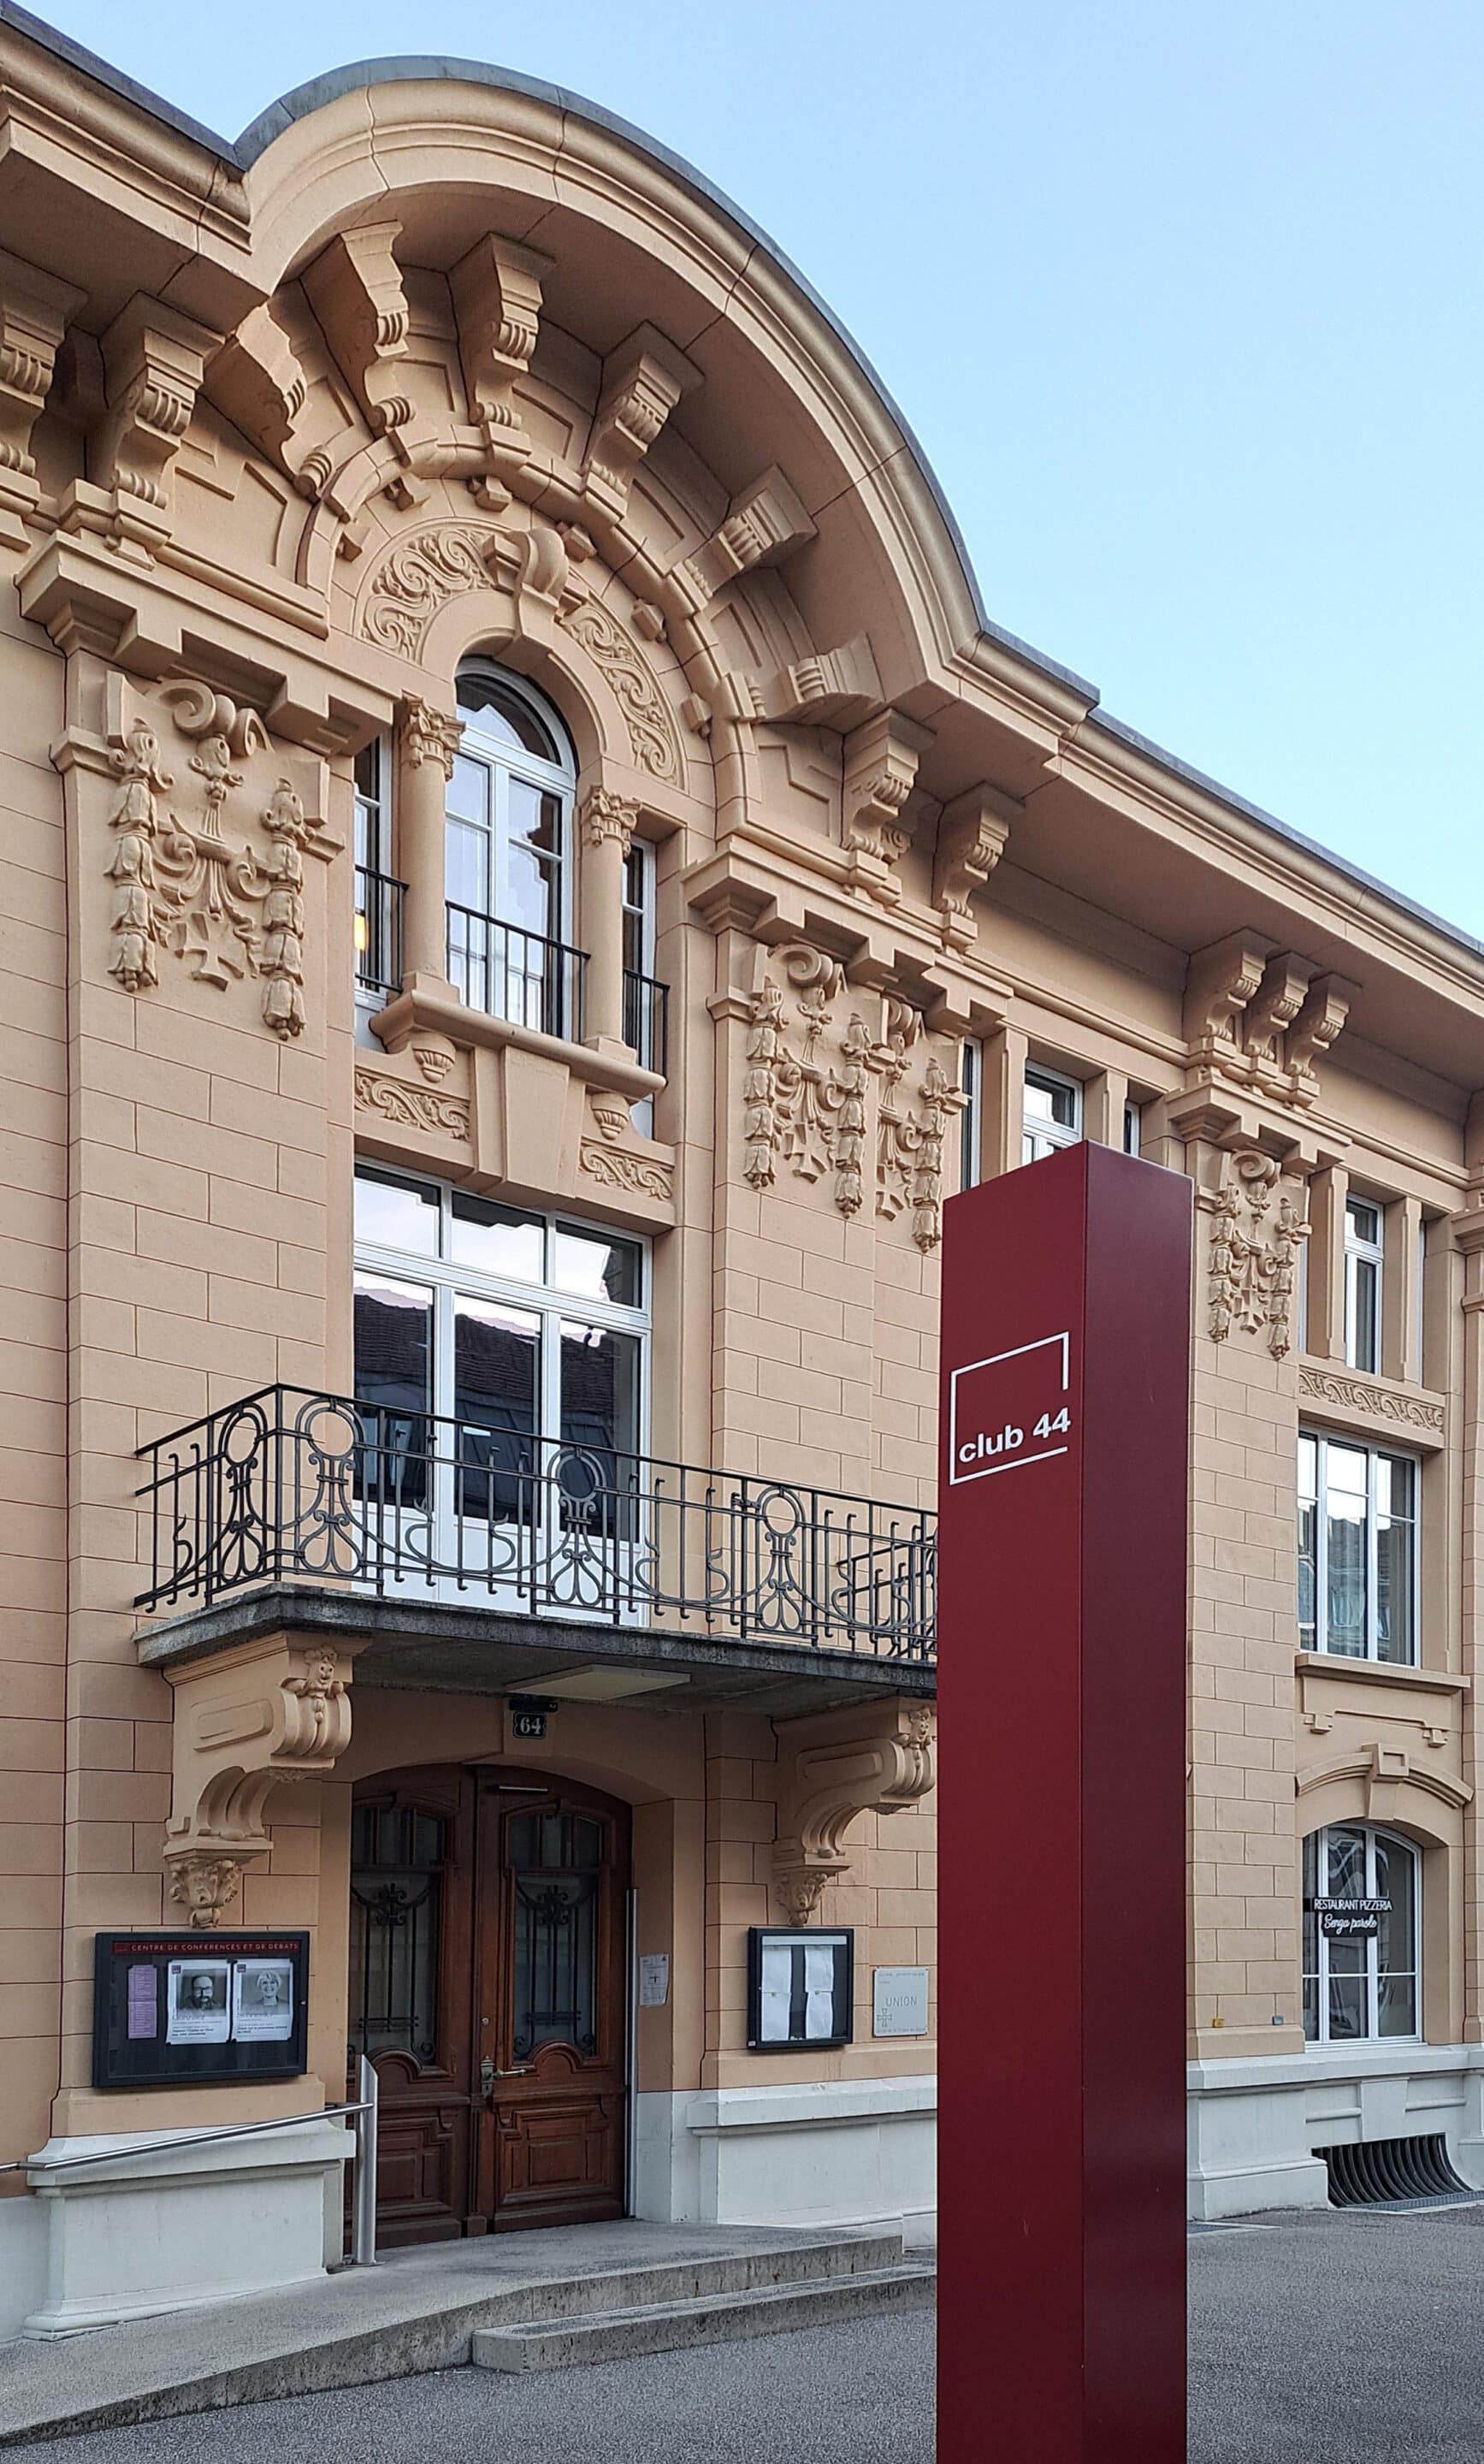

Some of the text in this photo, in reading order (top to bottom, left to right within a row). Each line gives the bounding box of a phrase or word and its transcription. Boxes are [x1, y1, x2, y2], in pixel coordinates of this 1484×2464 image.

[959, 1407, 1071, 1463] club 44
[520, 1717, 541, 1735] 64
[1314, 1898, 1392, 1910] RESTAURANT PIZZERIA
[885, 1995, 918, 2007] UNION
